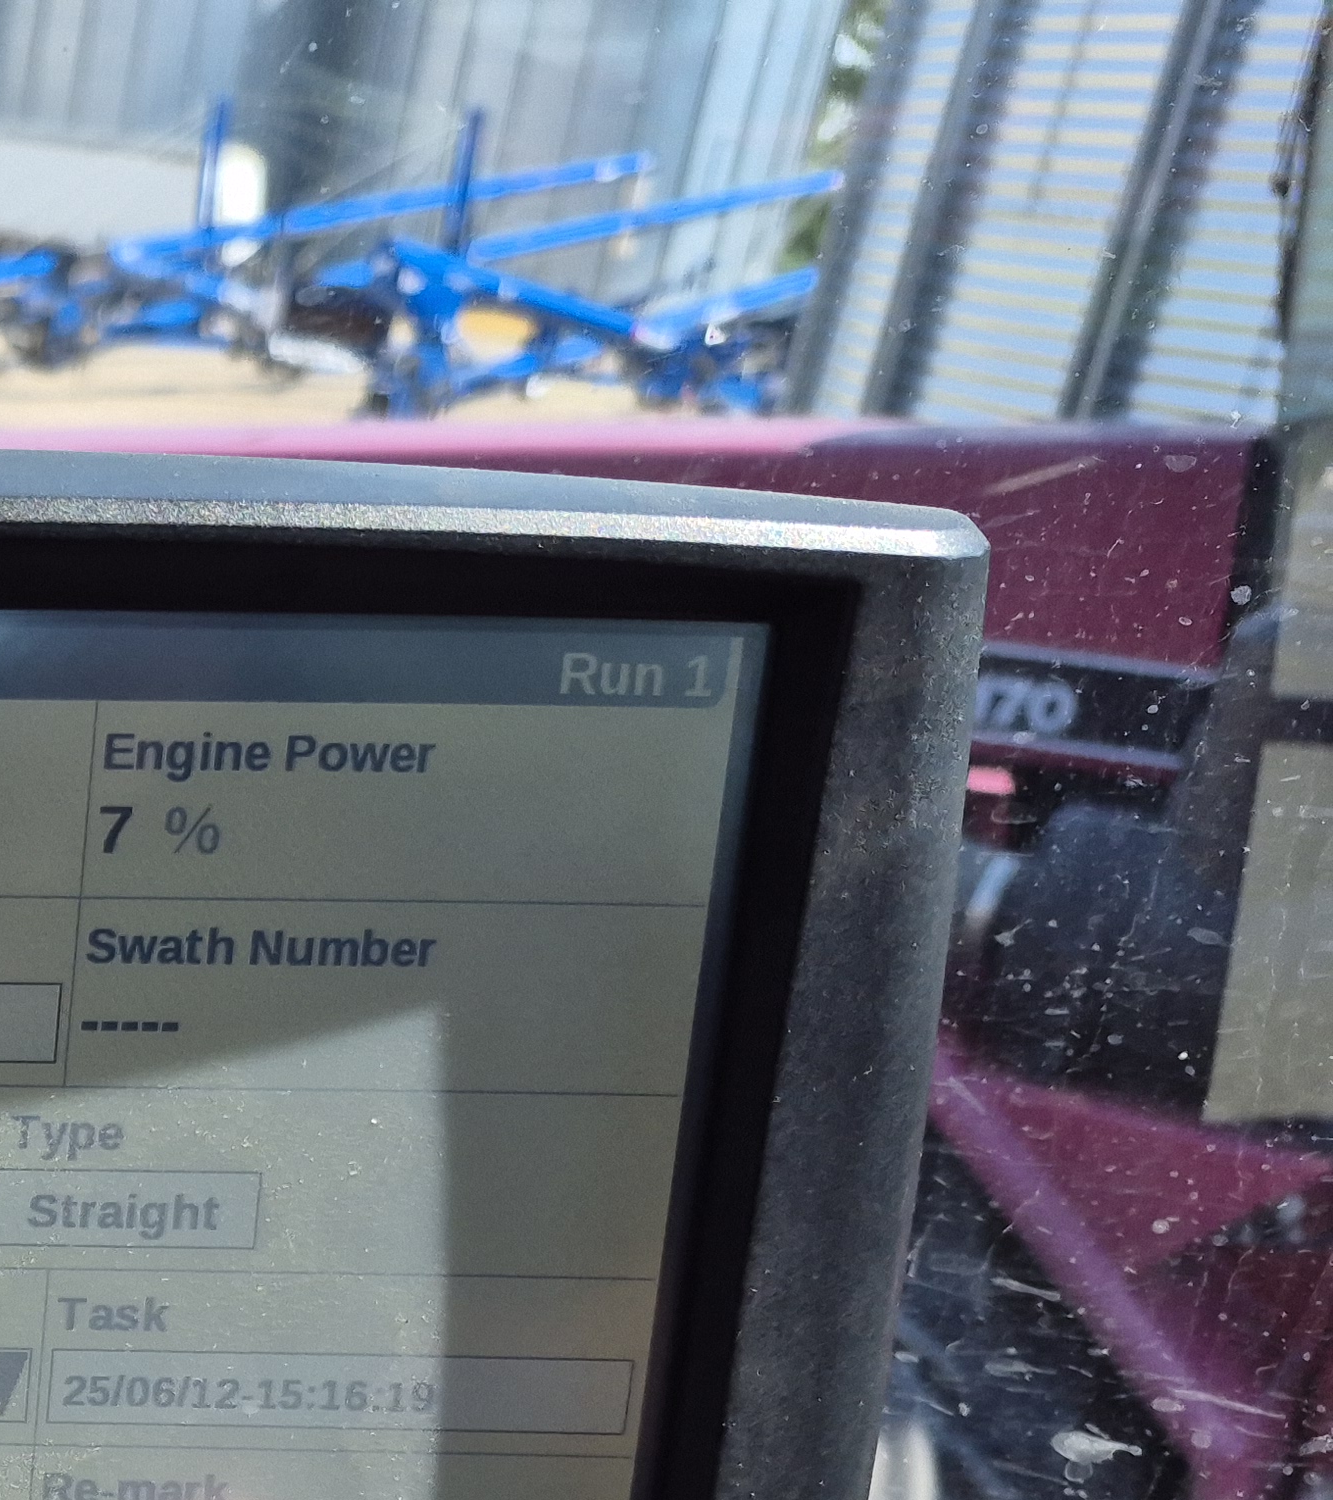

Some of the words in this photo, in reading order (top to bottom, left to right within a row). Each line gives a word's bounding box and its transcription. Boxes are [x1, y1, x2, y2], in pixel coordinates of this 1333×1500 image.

[558, 651, 665, 697] Run
[685, 656, 712, 698] 1
[103, 732, 271, 782] Engine
[284, 735, 436, 774] Power
[99, 805, 133, 854] 7
[163, 805, 220, 854] %
[85, 928, 234, 965] Swath
[249, 929, 436, 967] Number
[11, 1115, 125, 1160] Type
[28, 1193, 220, 1240] Straight
[58, 1297, 169, 1332] Task
